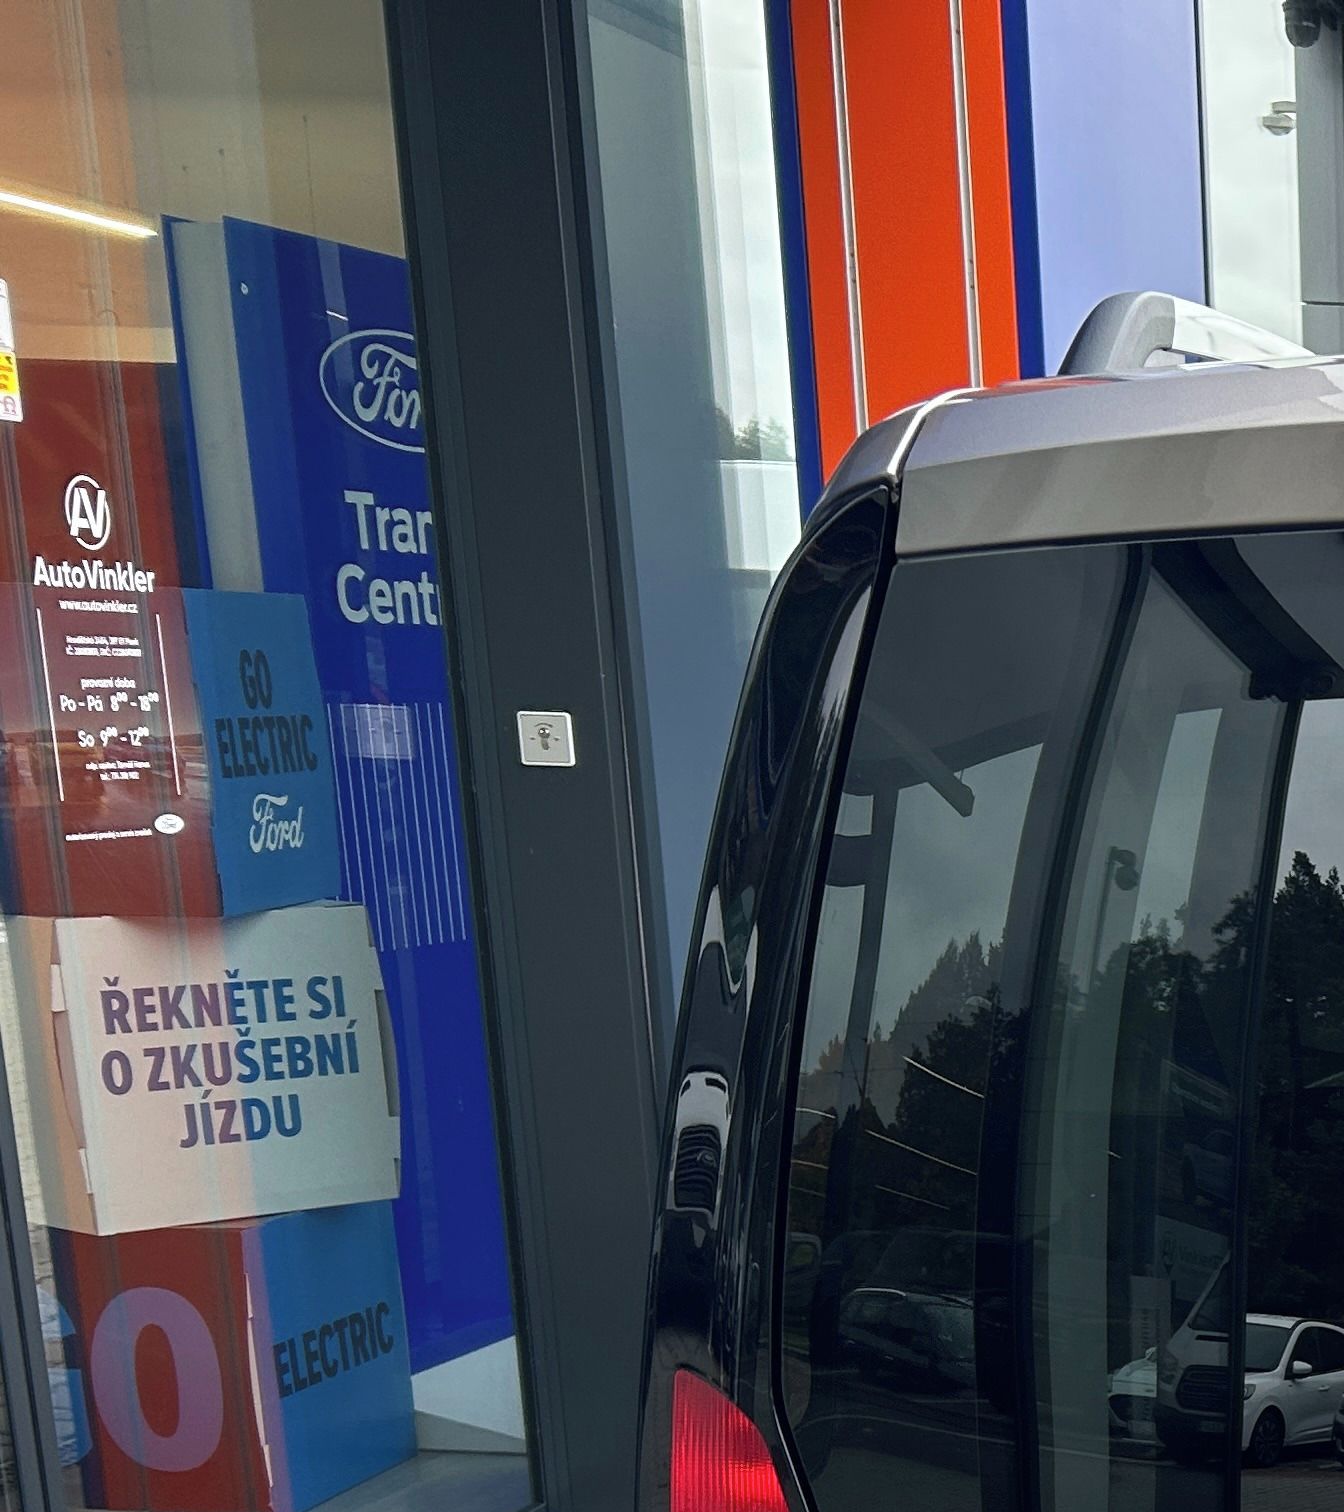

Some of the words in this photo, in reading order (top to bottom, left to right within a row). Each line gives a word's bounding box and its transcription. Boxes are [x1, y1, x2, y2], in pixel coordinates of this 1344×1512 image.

[352, 342, 421, 429] For
[34, 555, 155, 593] AutoVinkler
[59, 695, 77, 711] Po
[239, 649, 273, 709] GO
[78, 730, 95, 747] So
[215, 714, 318, 778] ELECTRIC
[250, 793, 304, 853] Ford
[100, 968, 297, 1035] ŘEKNĚTE
[306, 975, 346, 1020] SI
[101, 1050, 133, 1095] O
[143, 1019, 359, 1092] ZKUŠEBNÍ
[179, 1088, 302, 1148] JÍZDU
[273, 1302, 394, 1398] ELECTRIC
